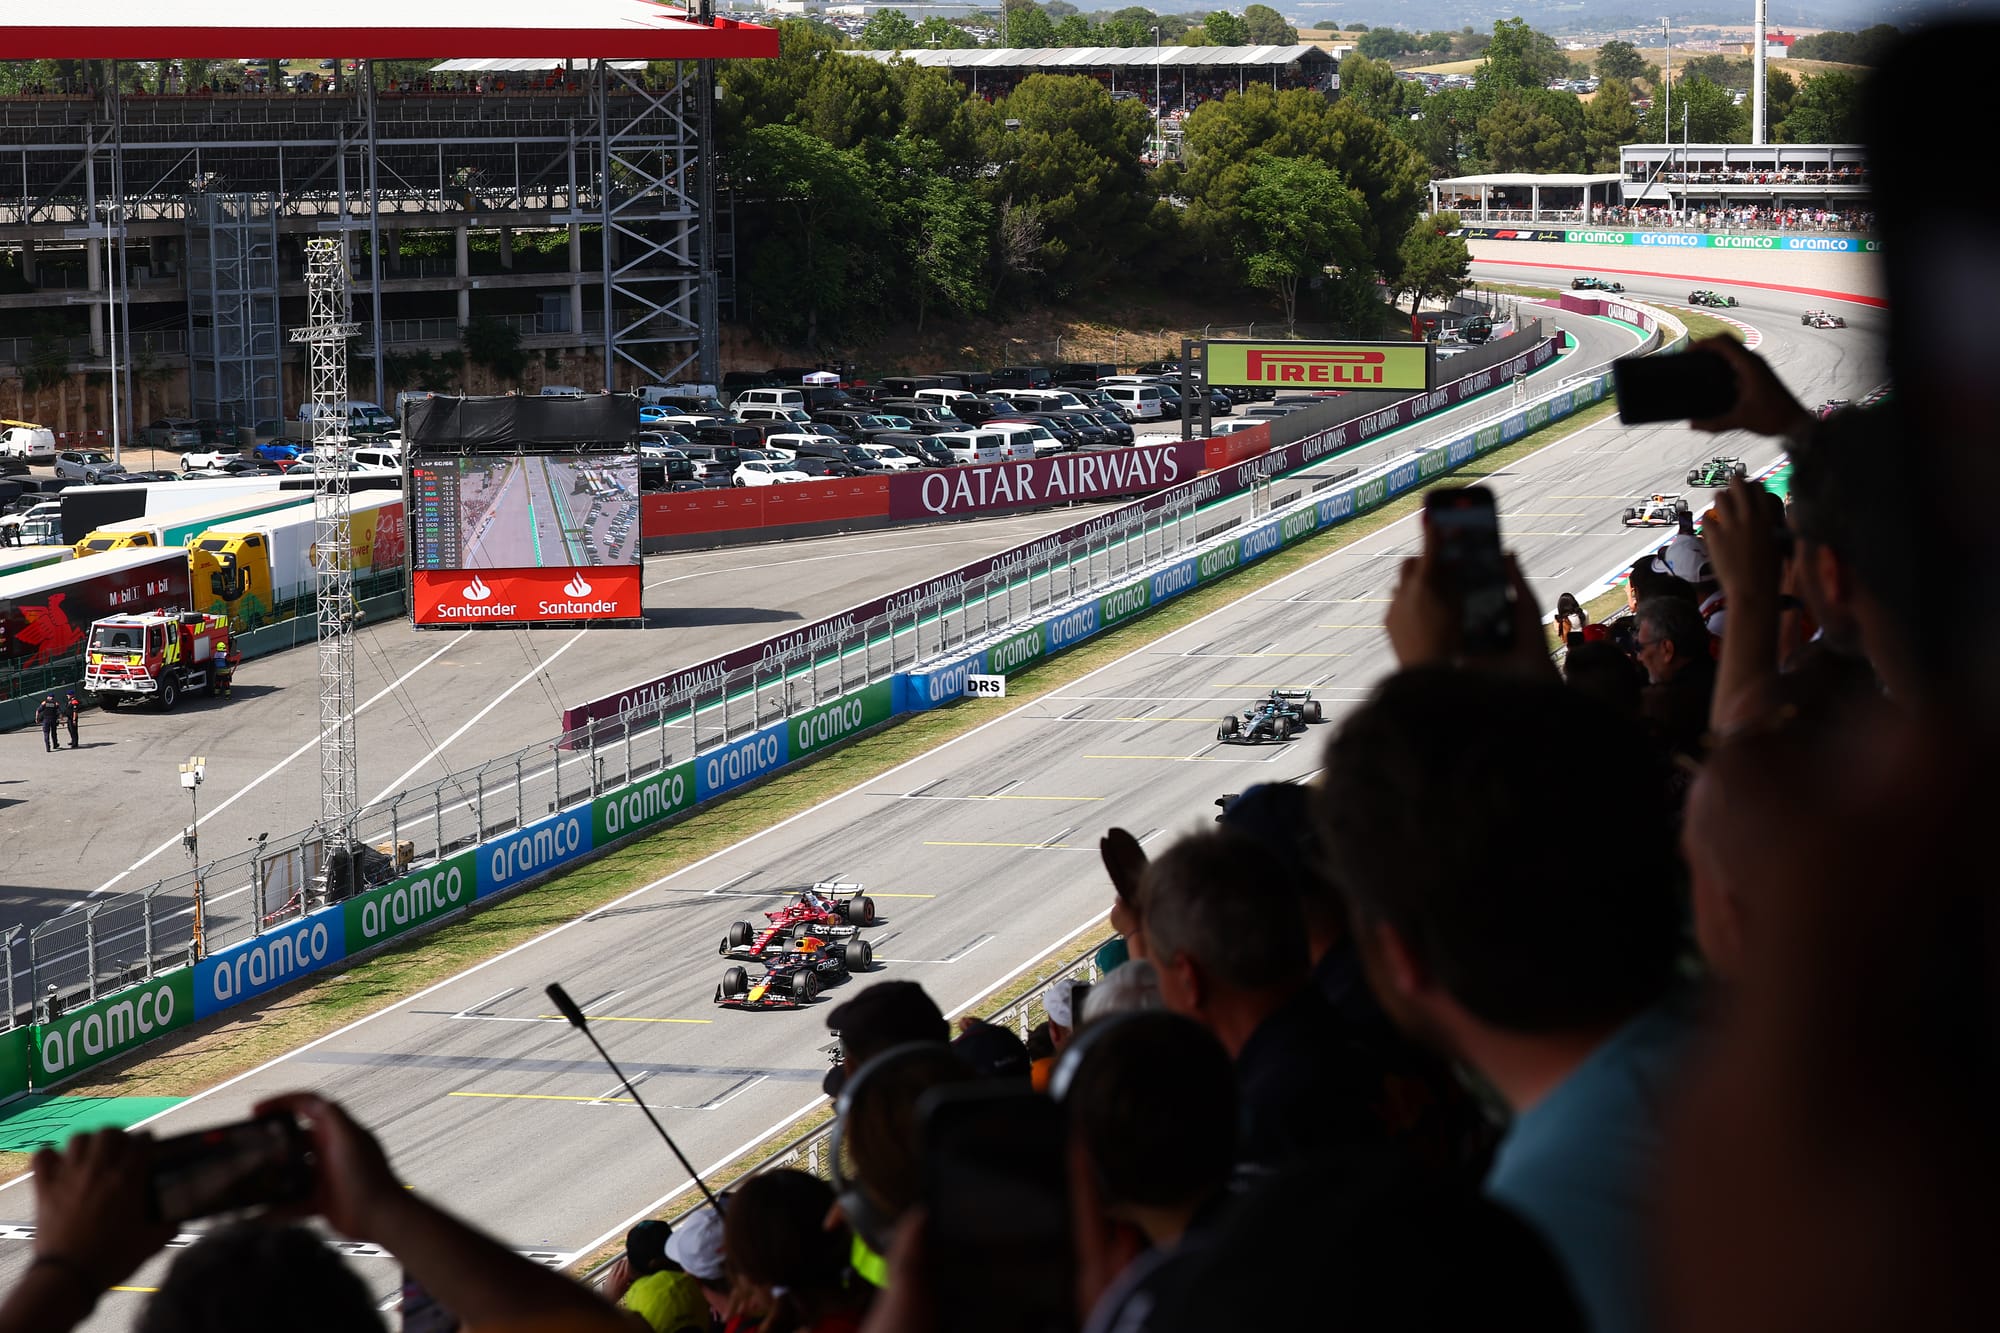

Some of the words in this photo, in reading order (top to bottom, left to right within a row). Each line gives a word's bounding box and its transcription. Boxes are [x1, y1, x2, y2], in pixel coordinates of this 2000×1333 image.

[1568, 231, 1625, 244] aramco
[1640, 233, 1698, 246] aramco
[1714, 235, 1772, 248] aramco
[1790, 237, 1848, 250] aramco
[1247, 350, 1385, 383] PIRELLI
[1458, 378, 1474, 399] QATAR
[1474, 371, 1492, 391] AIRWAYS
[1411, 395, 1428, 418] QATAR
[1428, 388, 1448, 410] AIRWAYS
[1528, 404, 1548, 426] aramco
[1359, 415, 1377, 439] QATAR
[1378, 406, 1399, 430] AIRWAYS
[1503, 416, 1524, 438] aramco
[1302, 438, 1321, 462] QATAR
[1322, 428, 1346, 453] AIRWAYS
[1450, 439, 1472, 462] aramco
[1477, 427, 1498, 450] aramco
[1238, 460, 1259, 487] QATAR
[1261, 450, 1288, 477] AIRWAYS
[1390, 465, 1415, 490] aramco
[1421, 451, 1444, 475] aramco
[922, 464, 1034, 515] QATAR
[1045, 447, 1178, 497] AIRWAYS
[1357, 480, 1383, 508] aramco
[1321, 495, 1351, 520] aramco
[1285, 509, 1314, 538] aramco
[1244, 527, 1276, 558] aramco
[1201, 544, 1236, 576] aramco
[147, 578, 168, 596] Mobil
[1155, 563, 1192, 597] aramco
[110, 588, 131, 606] Mobil
[438, 604, 516, 618] Santander
[538, 599, 618, 614] Santander
[1105, 585, 1144, 620] aramco
[1053, 607, 1094, 645] aramco
[763, 632, 803, 673] QATAR
[808, 613, 855, 650] AIRWAYS
[995, 632, 1039, 672] aramco
[619, 682, 666, 723] QATAR
[670, 660, 727, 703] AIRWAYS
[968, 680, 1000, 692] DRS
[799, 698, 862, 749] aramco
[708, 734, 778, 789] aramco
[606, 774, 684, 833] aramco
[492, 818, 580, 882] aramco
[362, 867, 462, 938] aramco
[214, 922, 328, 1000] aramco
[42, 985, 174, 1074] aramco
